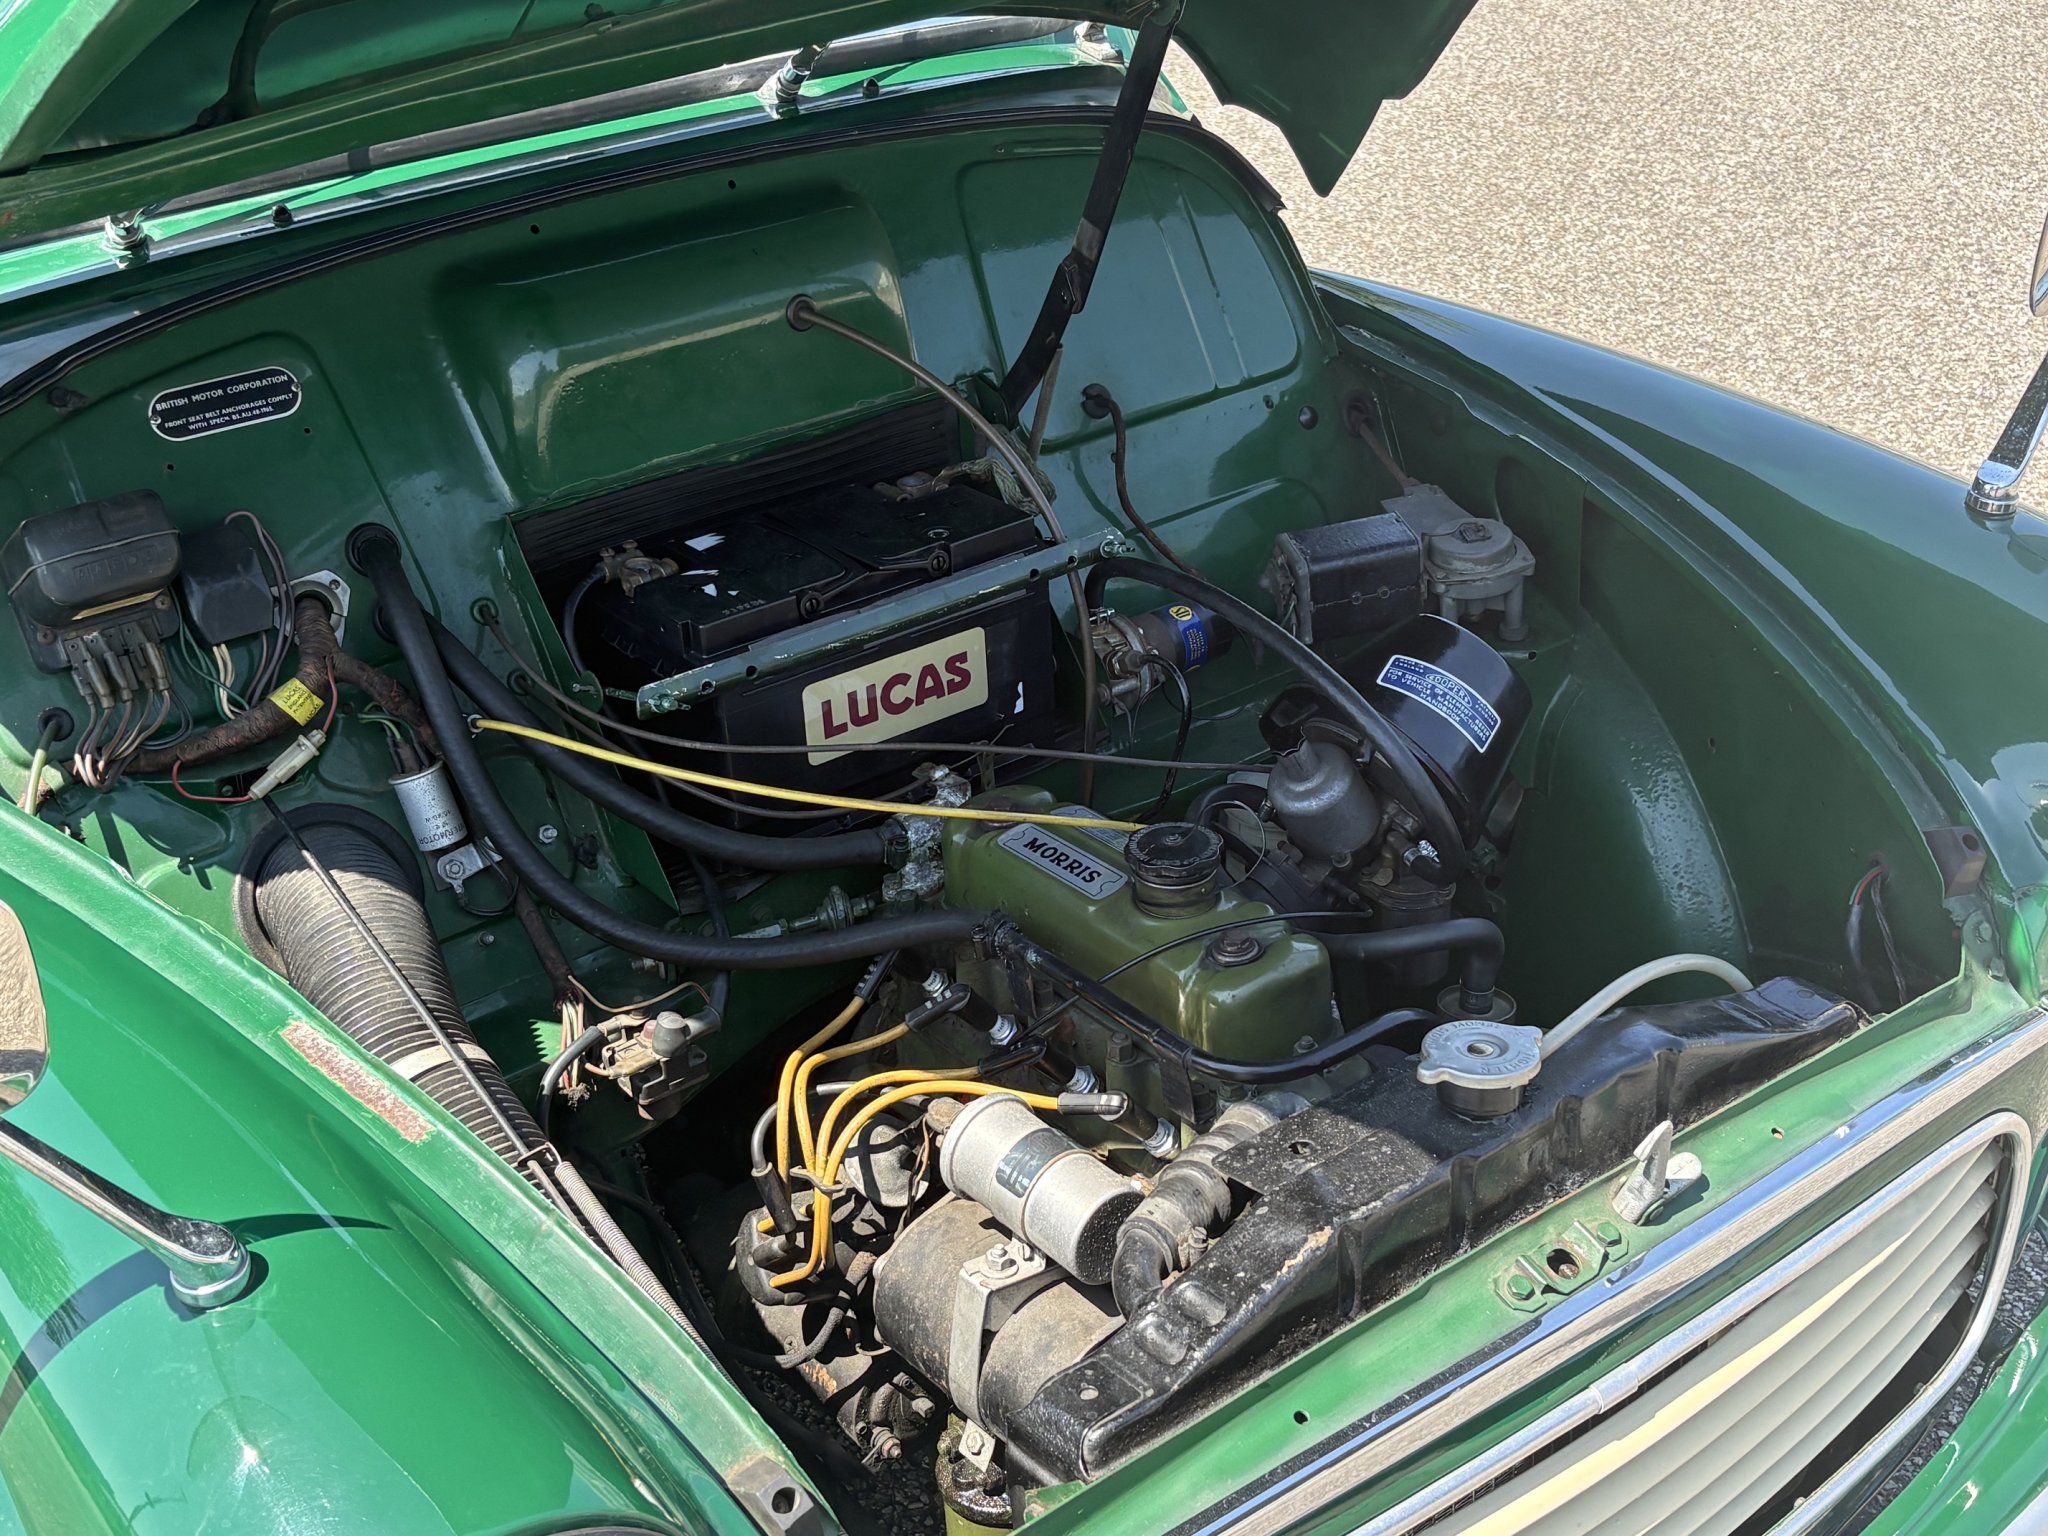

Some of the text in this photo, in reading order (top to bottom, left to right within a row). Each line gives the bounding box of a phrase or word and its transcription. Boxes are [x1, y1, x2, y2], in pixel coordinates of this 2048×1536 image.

[155, 374, 289, 411] BRITISH MOTOR CORPORATION
[164, 392, 294, 429] FRONT SEAT BELT ANCHORAGES COMPLY
[188, 421, 208, 431] WITH
[282, 686, 302, 704] LUCAS
[820, 650, 972, 740] LUCAS
[1388, 669, 1491, 737] FOR SERVICE OF ELEMENT REFER
[1401, 678, 1432, 695] VEHICLE
[1437, 695, 1487, 742] MANUFACTURERS
[1420, 693, 1461, 723] HANDBOOK
[1022, 837, 1102, 884] MORRIS
